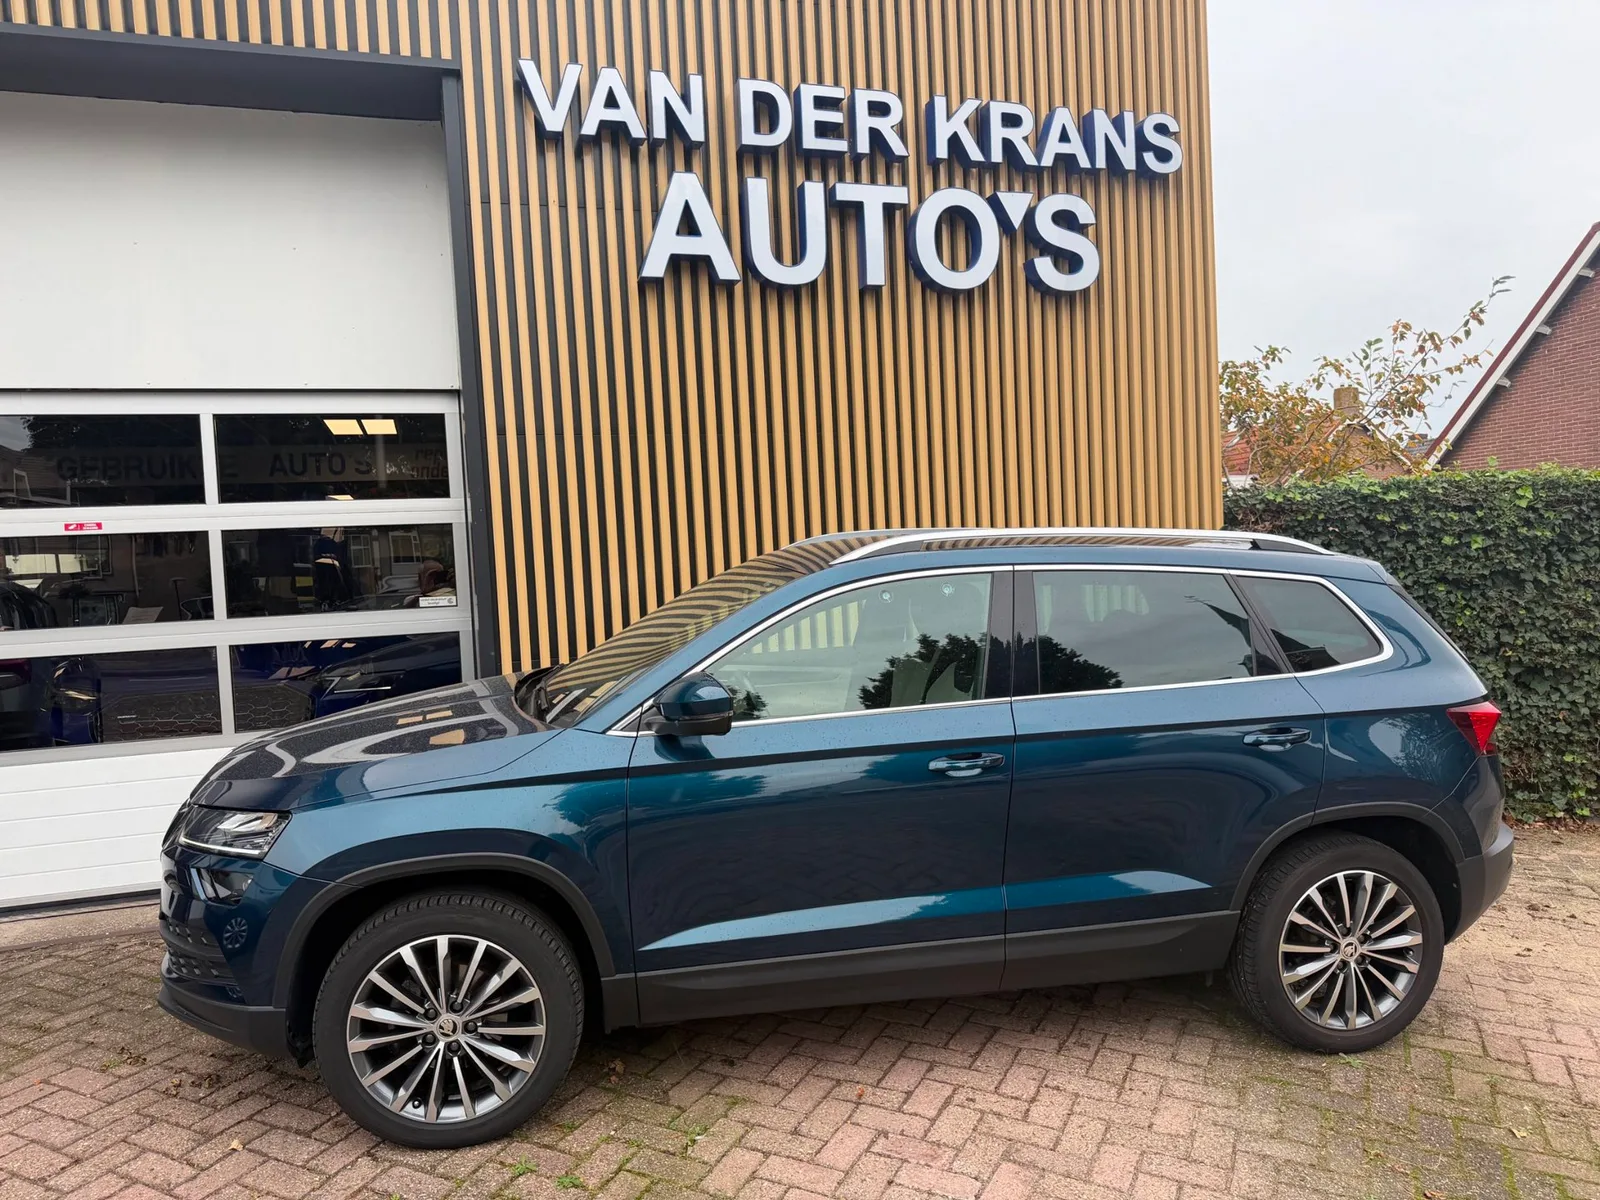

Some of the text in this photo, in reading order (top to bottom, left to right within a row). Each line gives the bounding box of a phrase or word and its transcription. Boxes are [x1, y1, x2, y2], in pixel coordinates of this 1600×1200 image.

[517, 58, 1184, 176] VAN DER KRANS
[637, 170, 1101, 293] AUTO'S
[57, 454, 239, 480] GEBRUIKE
